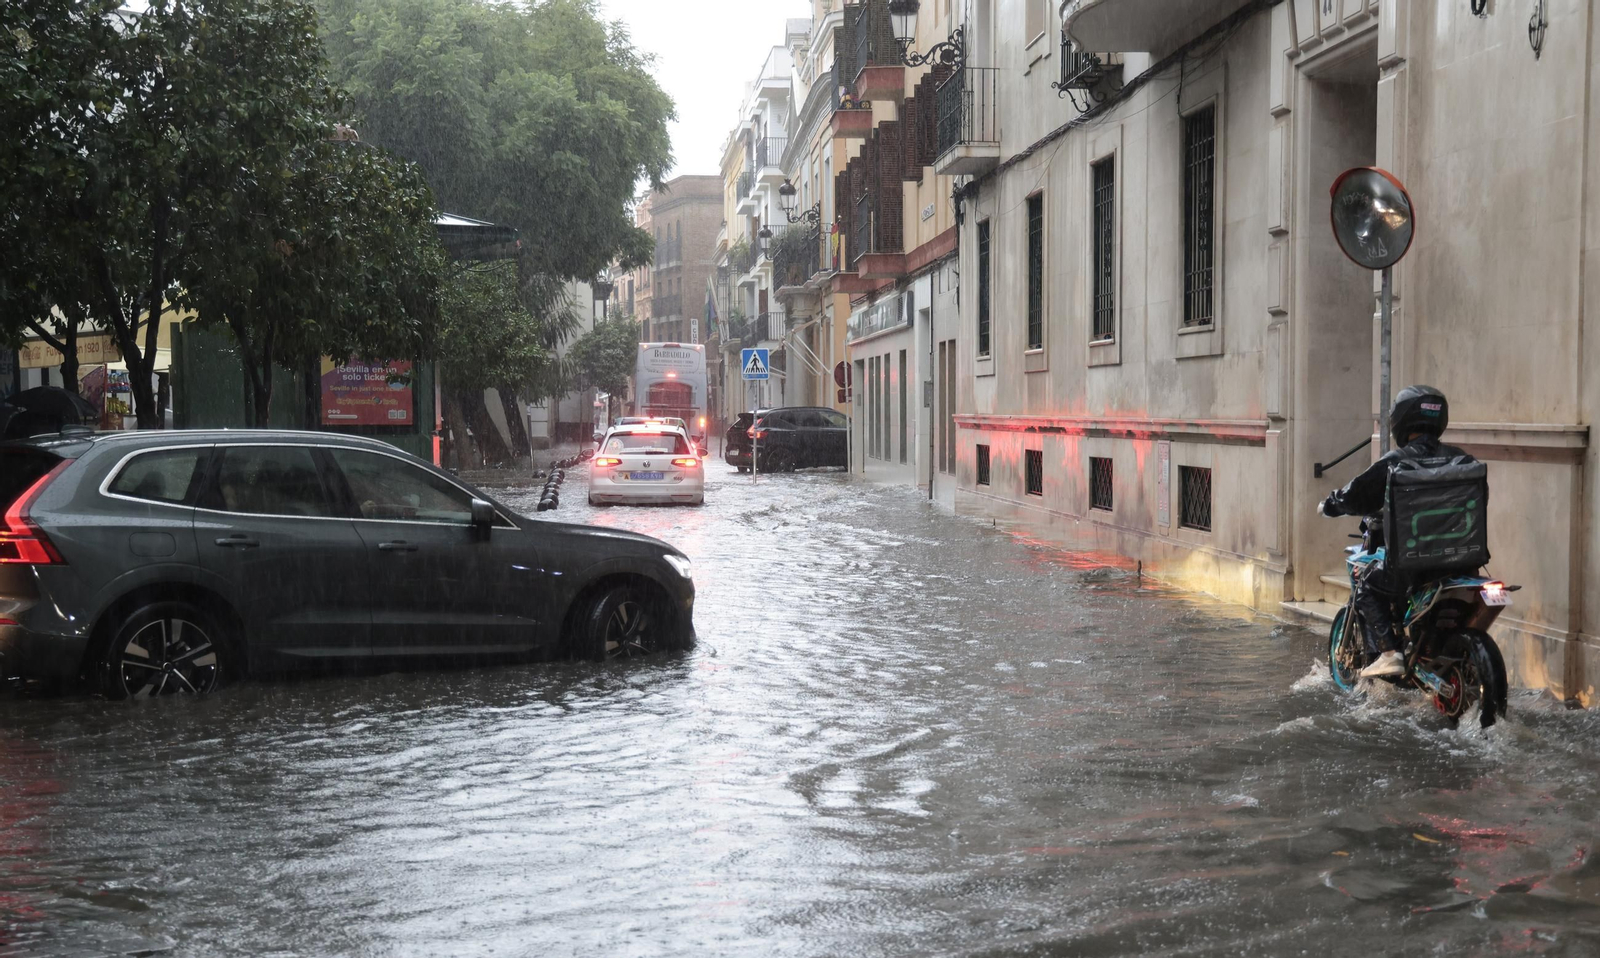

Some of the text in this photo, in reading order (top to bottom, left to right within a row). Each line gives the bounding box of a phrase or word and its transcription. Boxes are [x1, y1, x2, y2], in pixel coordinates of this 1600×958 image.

[84, 342, 100, 353] 1920
[336, 364, 370, 375] ¡Sevilla
[342, 373, 388, 381] solo ticke
[1406, 545, 1481, 558] CLOSER
